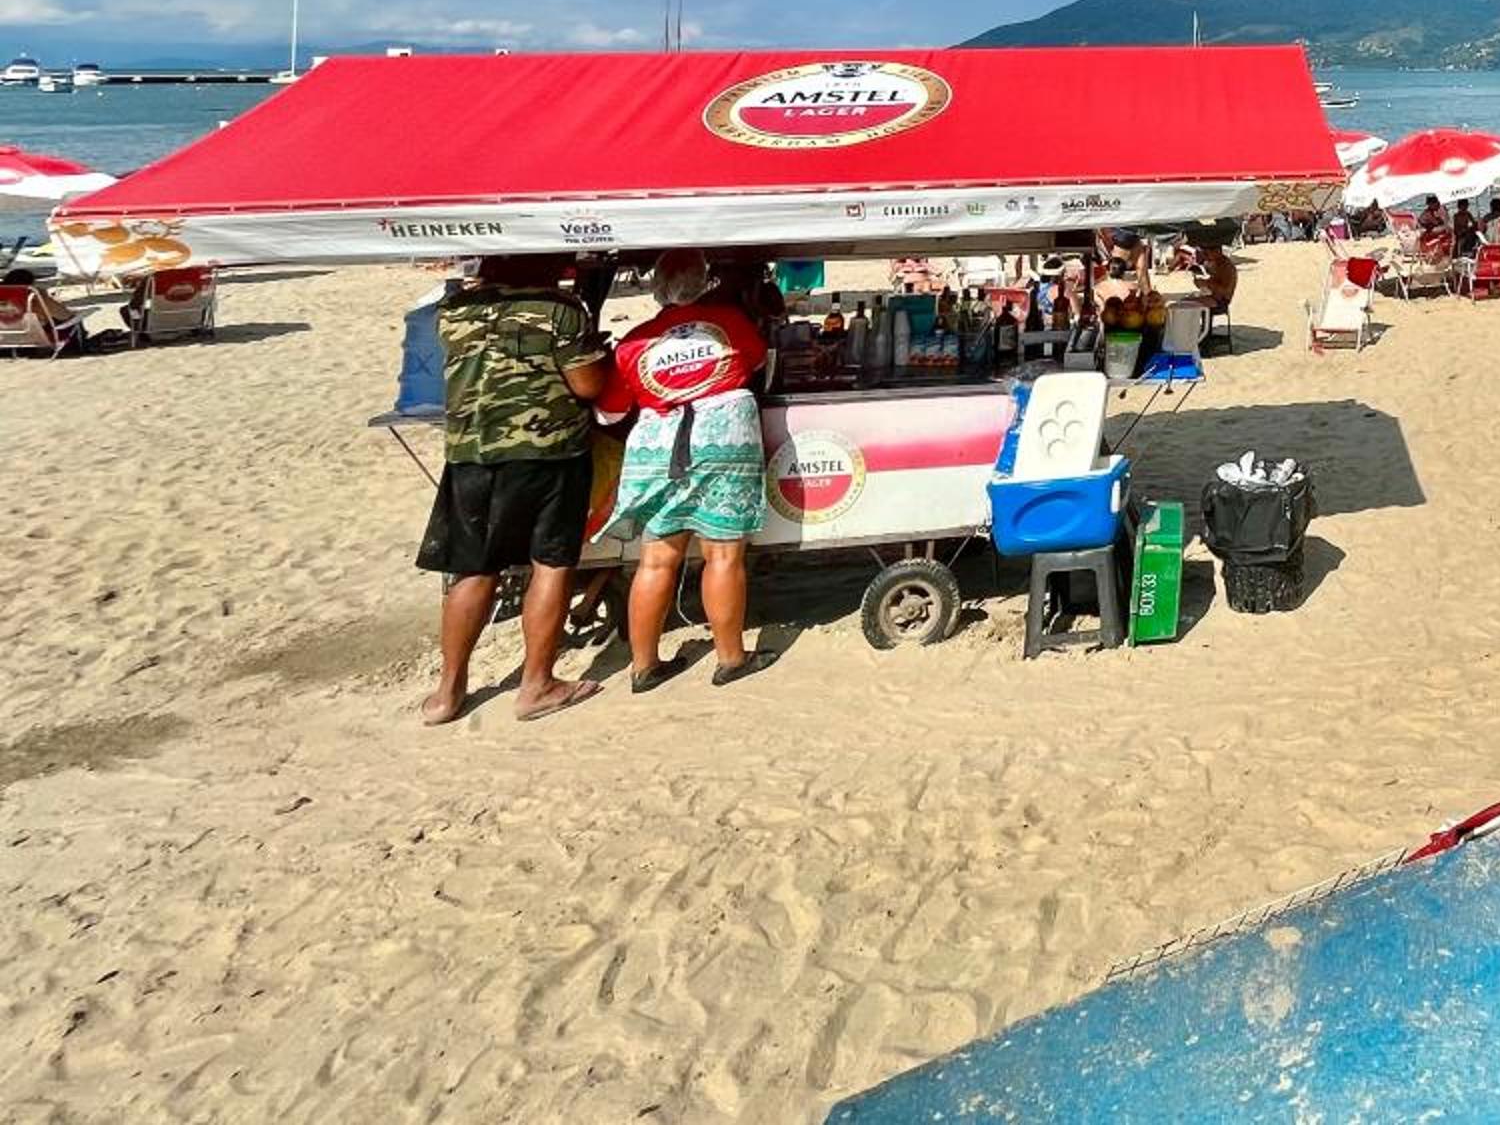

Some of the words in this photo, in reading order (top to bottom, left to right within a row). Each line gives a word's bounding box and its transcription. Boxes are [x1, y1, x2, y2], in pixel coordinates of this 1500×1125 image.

[761, 90, 908, 104] AMSTEL
[783, 107, 867, 118] LAGER
[391, 222, 503, 238] HEINEKEN
[560, 222, 612, 234] Verão
[656, 345, 715, 366] AMSTEL
[788, 460, 845, 475] AMSTEL
[1141, 574, 1157, 588] 33
[1139, 590, 1155, 616] BOX
